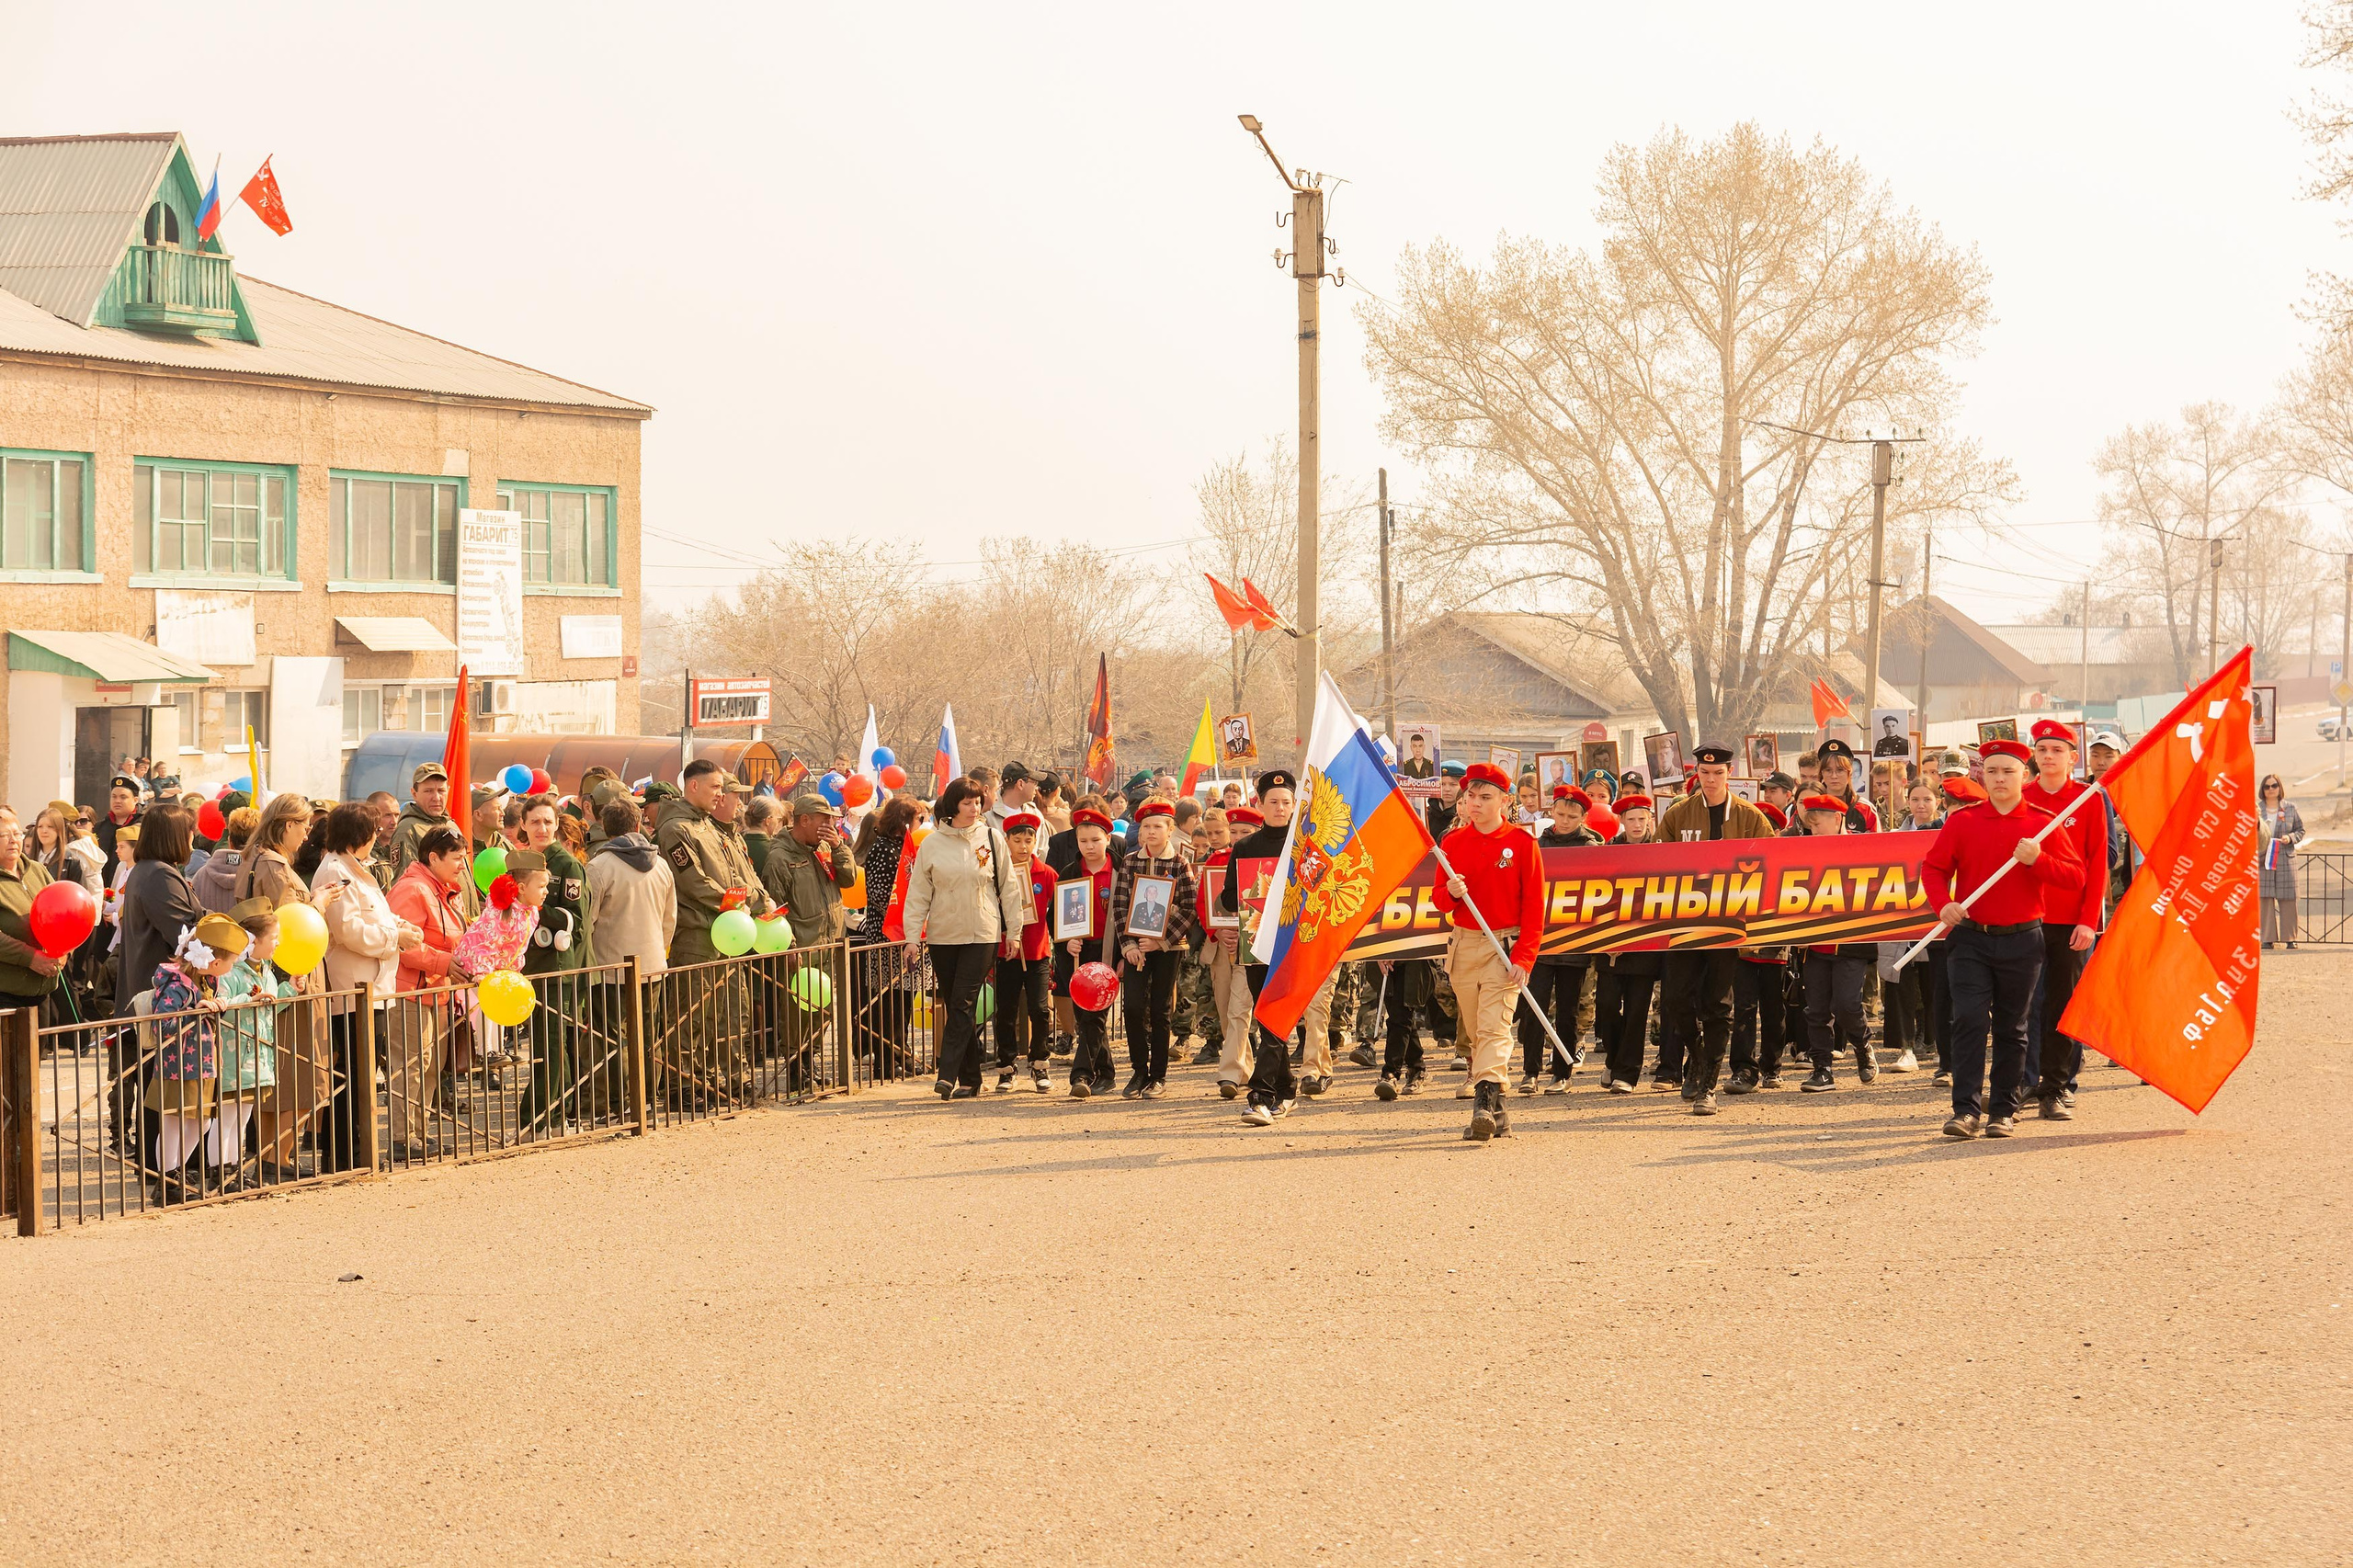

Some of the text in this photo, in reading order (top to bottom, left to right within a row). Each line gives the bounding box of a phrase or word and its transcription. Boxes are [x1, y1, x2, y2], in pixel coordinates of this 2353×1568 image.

[476, 511, 506, 523] Магазин
[463, 525, 509, 543] ГАБАРИТ
[700, 695, 761, 719] ГАБАРИТ
[1399, 779, 1440, 788] АБРОСИМОВ
[1381, 861, 1764, 930] БЕЕРТНЫЙ
